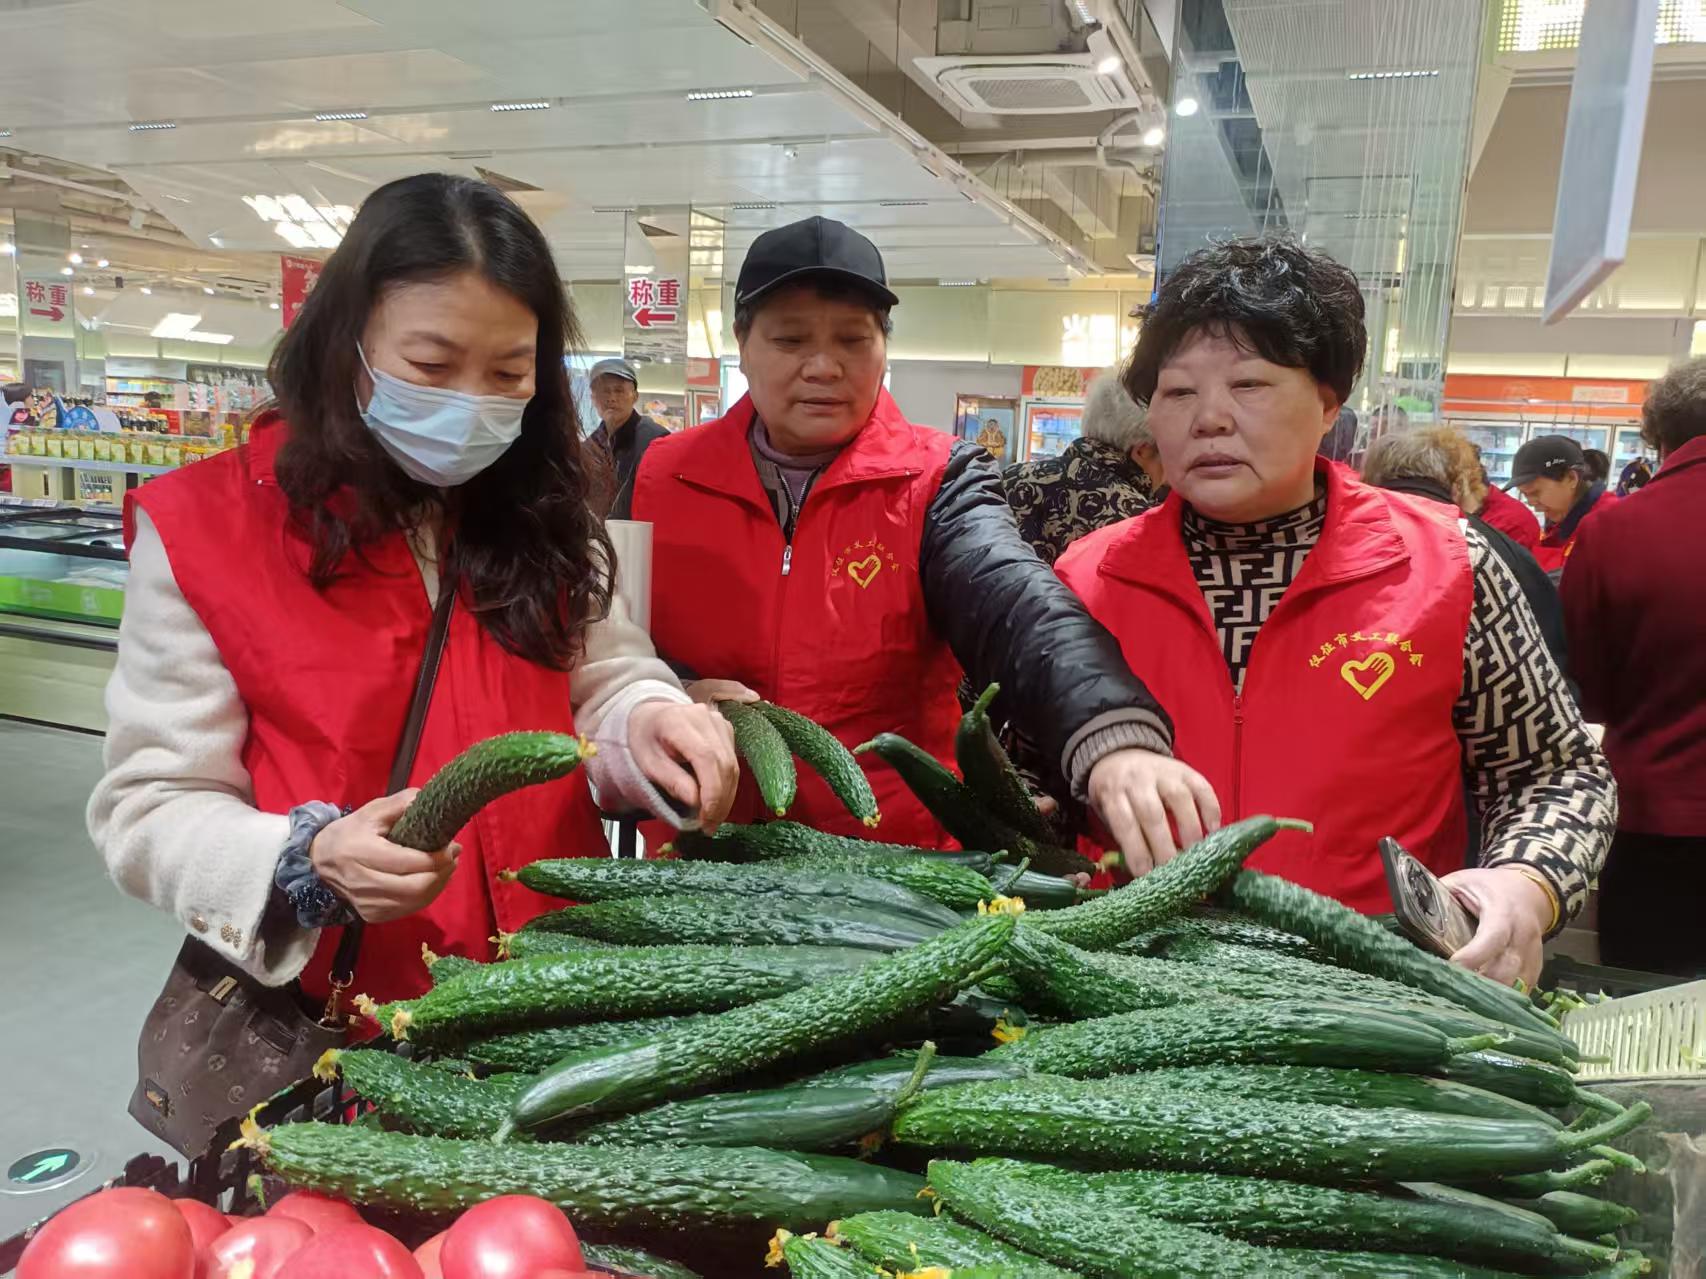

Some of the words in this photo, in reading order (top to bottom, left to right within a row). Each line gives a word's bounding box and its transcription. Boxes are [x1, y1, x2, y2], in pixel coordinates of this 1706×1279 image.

[26, 281, 68, 306] 称重
[630, 279, 681, 306] 称重
[1309, 631, 1424, 668] 仪征市义工联合会
